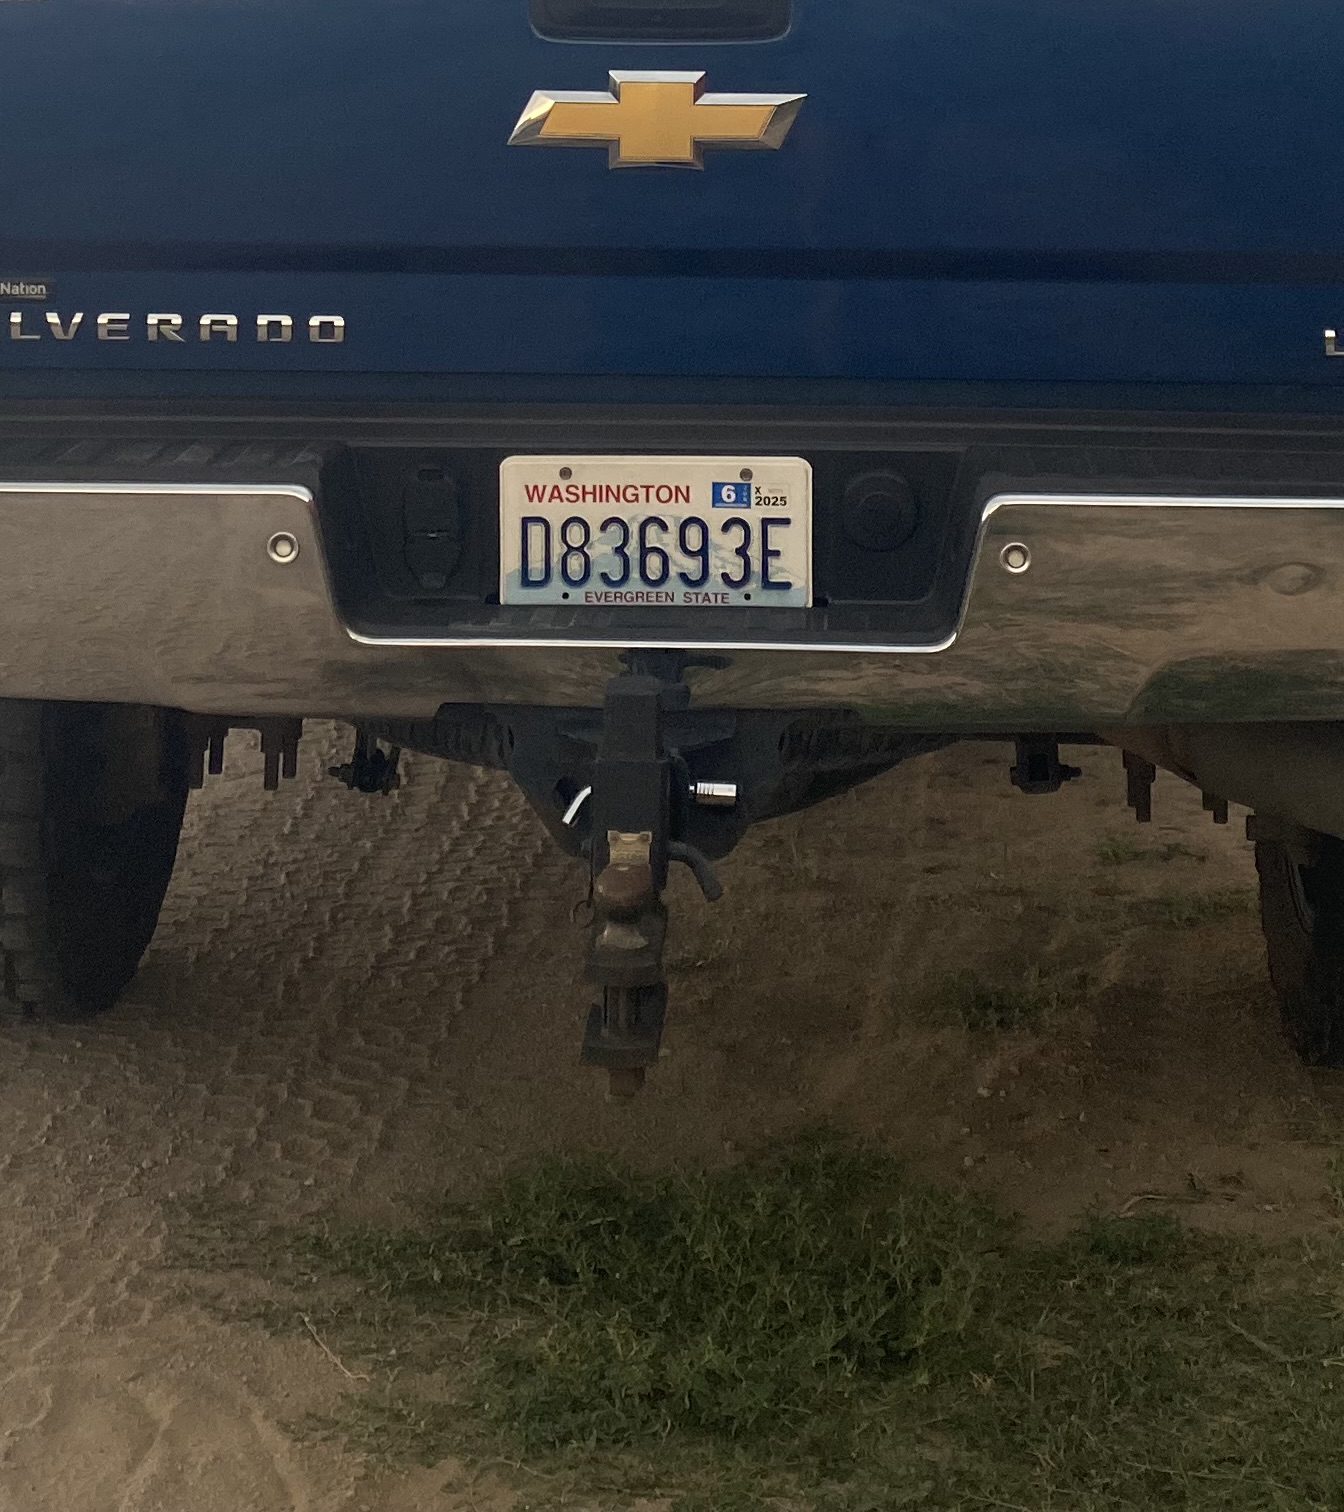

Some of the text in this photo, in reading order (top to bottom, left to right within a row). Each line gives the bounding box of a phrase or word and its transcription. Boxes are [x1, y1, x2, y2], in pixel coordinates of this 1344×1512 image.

[524, 484, 691, 505] WASHINGTON
[721, 484, 736, 503] 6
[754, 486, 762, 495] X
[754, 496, 788, 507] 2025
[520, 515, 793, 590] D83693E
[584, 591, 731, 605] EVERGREEN STATE
